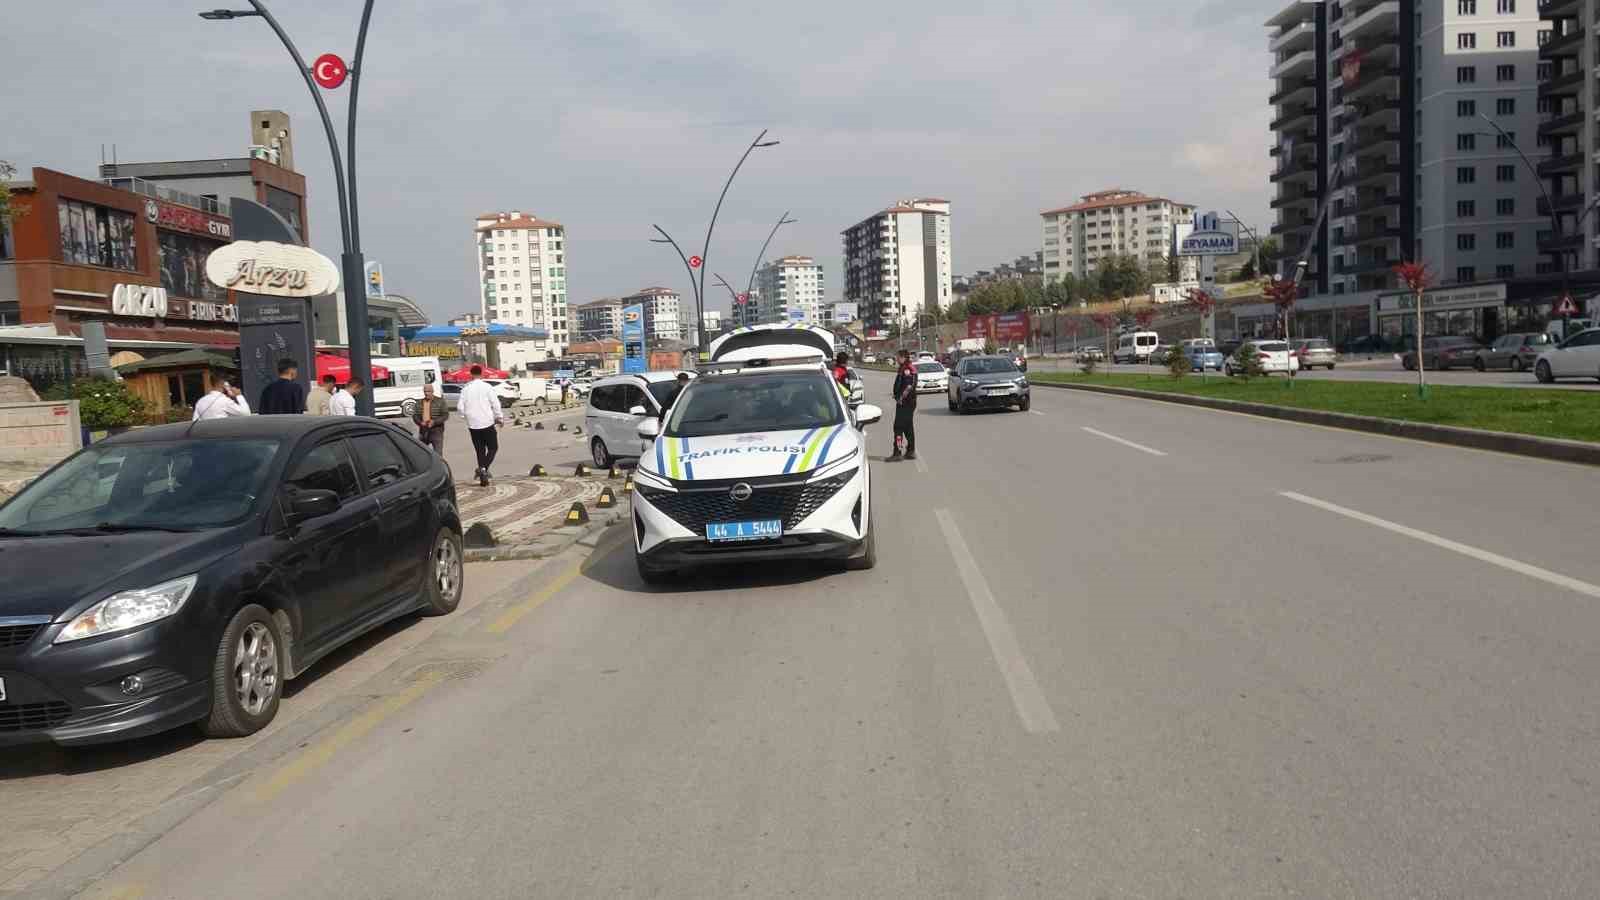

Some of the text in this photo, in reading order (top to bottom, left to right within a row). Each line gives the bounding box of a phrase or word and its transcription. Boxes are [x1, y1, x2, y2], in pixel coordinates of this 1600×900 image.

[208, 220, 231, 236] GYM
[226, 258, 307, 289] Arzu
[112, 283, 168, 318] ARZU
[714, 521, 780, 537] 44 A 5444
